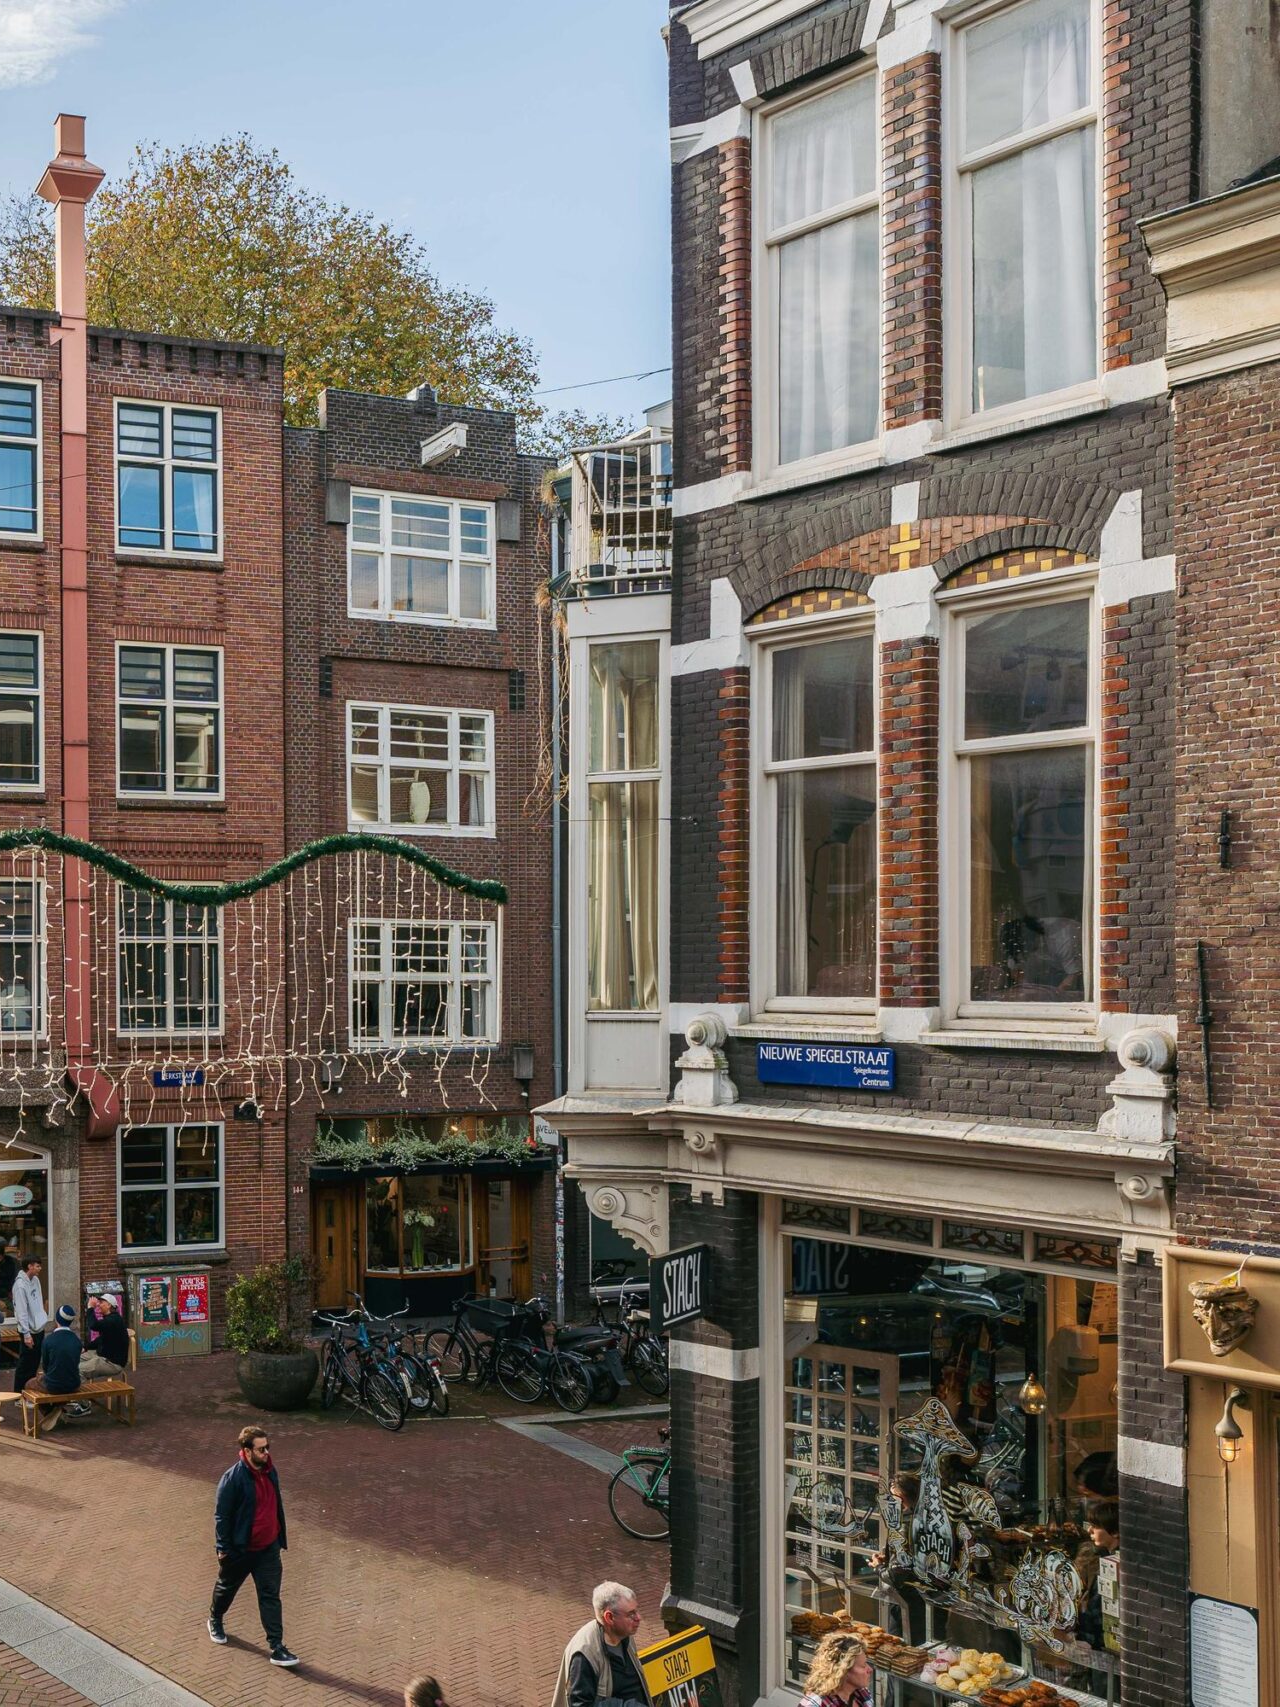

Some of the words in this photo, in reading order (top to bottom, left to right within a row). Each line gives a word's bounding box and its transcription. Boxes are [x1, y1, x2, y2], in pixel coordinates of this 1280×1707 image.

[760, 1046, 803, 1061] NIEUWE
[806, 1048, 890, 1066] SPIEGELSTRAAT
[853, 1066, 889, 1075] Spiegelkwartier
[861, 1077, 890, 1087] Centrum
[663, 1252, 702, 1319] STACH
[920, 1532, 950, 1562] STACH
[663, 1649, 692, 1682] STACH
[668, 1678, 699, 1707] NEW
